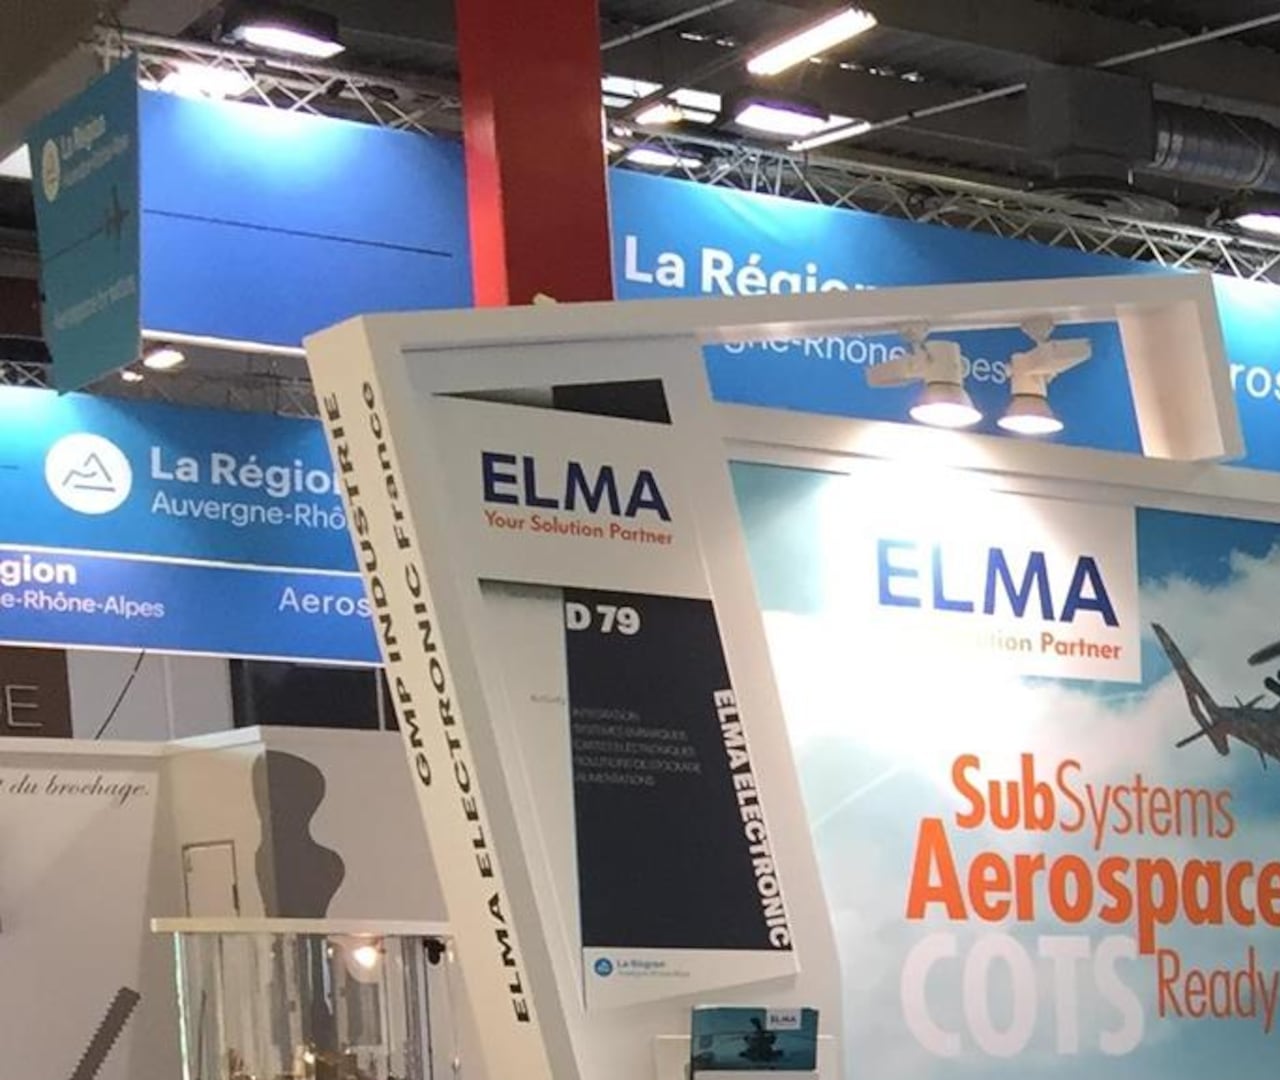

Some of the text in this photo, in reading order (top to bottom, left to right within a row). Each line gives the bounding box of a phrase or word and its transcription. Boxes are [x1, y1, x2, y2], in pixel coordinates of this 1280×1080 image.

[624, 236, 685, 288] La
[151, 446, 200, 483] La
[481, 450, 672, 522] ELMA
[484, 509, 673, 545] Your Solution Partner
[323, 392, 432, 787] GMP INDUSTRIE
[565, 603, 642, 635] D 79
[877, 538, 1121, 628] ELMA
[1040, 632, 1123, 661] Partner
[362, 380, 531, 1023] ELMA ELECTRONIC France
[713, 688, 794, 948] ELMA ELECTRONIC
[951, 752, 1236, 851] SubSystems
[899, 932, 1280, 1059] COTS Ready
